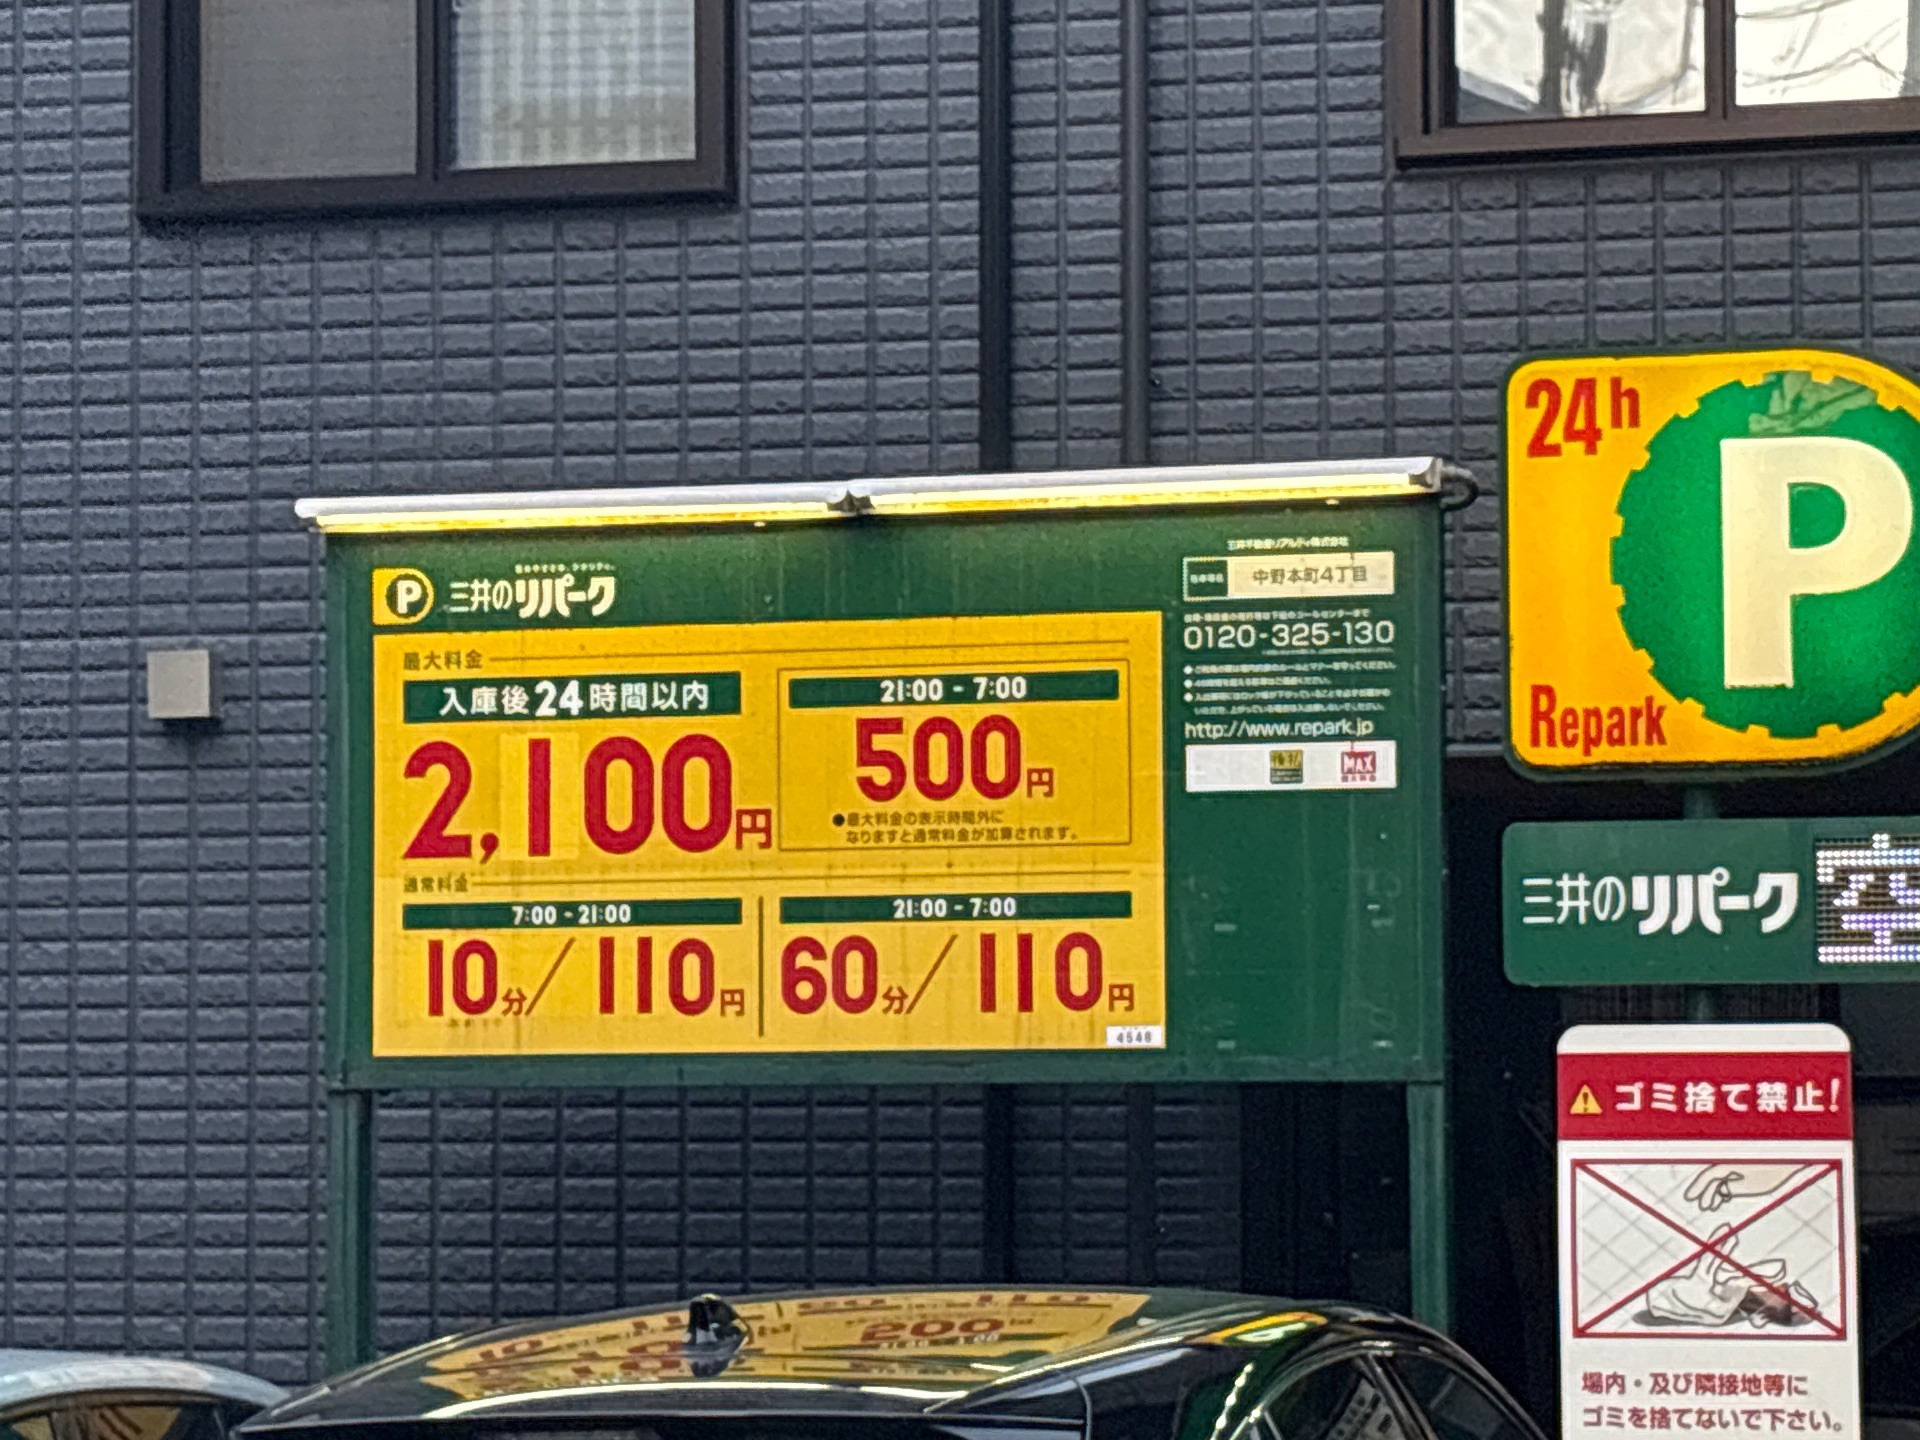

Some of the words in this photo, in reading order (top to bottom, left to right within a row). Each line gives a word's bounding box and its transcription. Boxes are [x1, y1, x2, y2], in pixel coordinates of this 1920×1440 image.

[1524, 376, 1641, 458] 24h
[1253, 565, 1368, 585] 中野本町4丁目
[1720, 435, 1912, 689] P
[448, 574, 616, 618] 三井のリパーク
[1184, 620, 1395, 649] 0120-325-130
[403, 650, 483, 671] 最大料金
[439, 680, 709, 717] 入庫後24時間以内
[880, 679, 943, 702] 21:00
[973, 676, 1027, 699] 7:00
[1184, 717, 1374, 740] http://www.repark.jp
[1529, 684, 1667, 757] Repark
[855, 714, 1055, 803] 500円
[402, 733, 773, 864] 2,100円
[846, 810, 1003, 827] 最大料金の表示時間外に
[511, 905, 557, 925] 7:00
[578, 903, 631, 924] 21:00
[893, 898, 947, 919] 21:00
[969, 896, 1017, 917] 7:00
[1522, 866, 1799, 936] 三井のリパーク
[1615, 1078, 1840, 1113] ゴミ捨て禁止!
[1582, 1372, 1808, 1397] 場内・及び隣接地等に
[1583, 1406, 1842, 1432] ゴミを捨てないで下さい。
